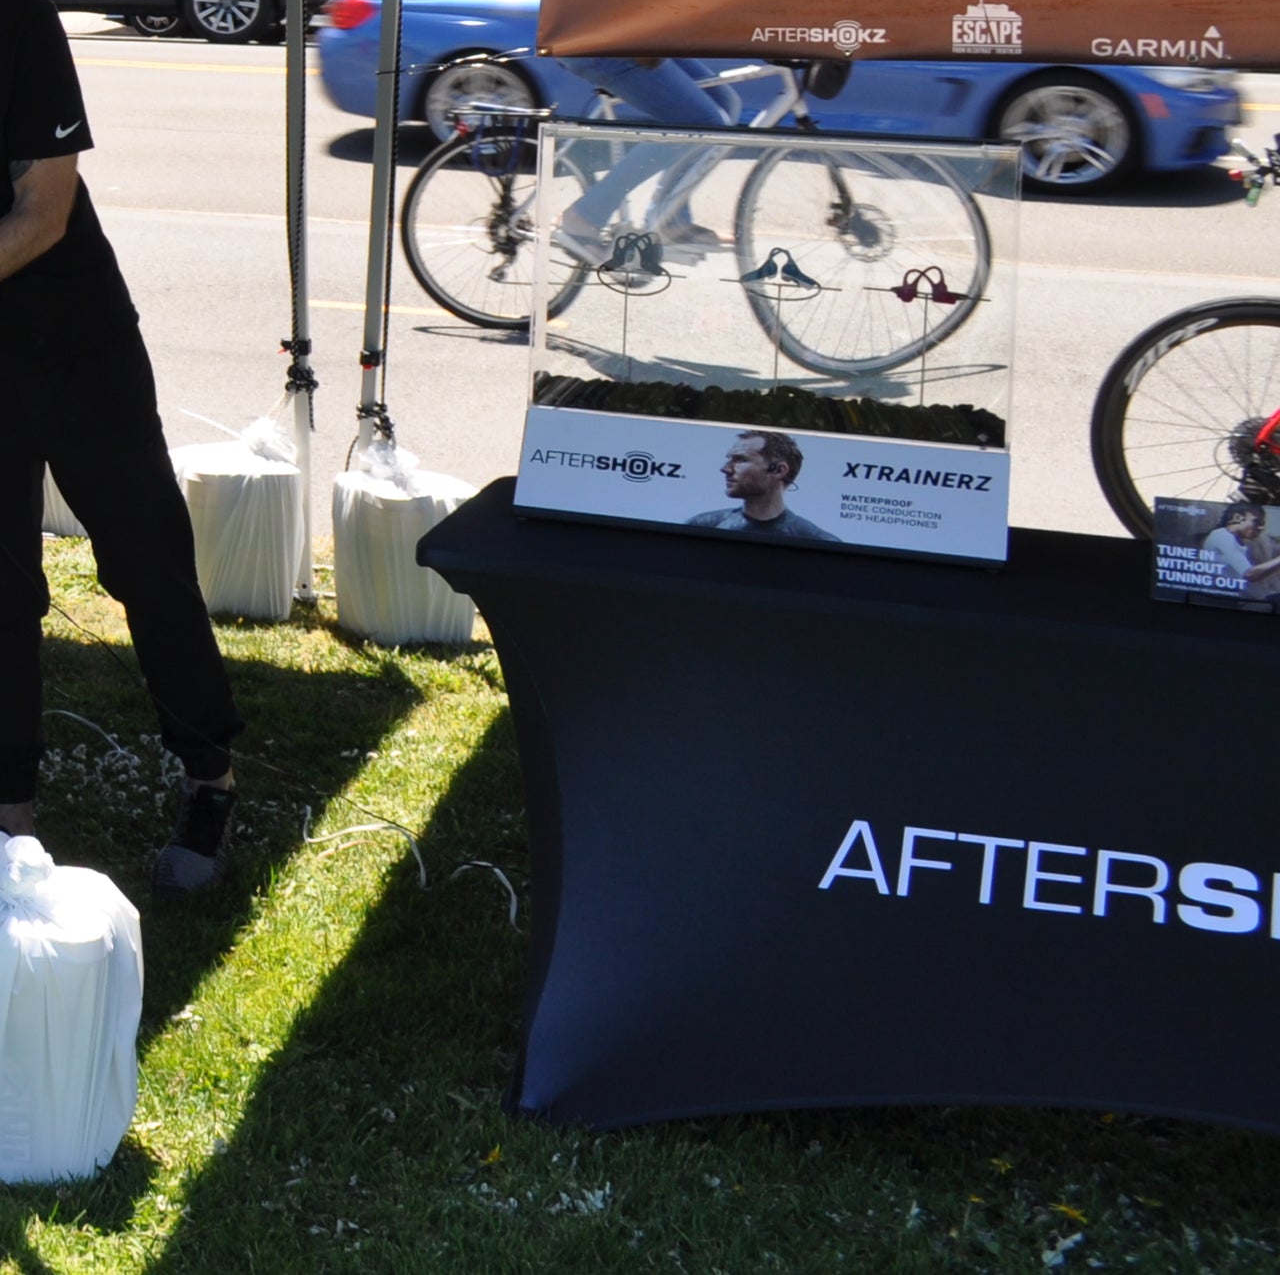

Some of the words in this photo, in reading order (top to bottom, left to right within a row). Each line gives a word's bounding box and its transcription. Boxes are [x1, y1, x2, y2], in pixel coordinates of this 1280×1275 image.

[751, 24, 886, 47] AFTERSHOKZ
[952, 20, 1022, 44] ESCAPE
[1091, 37, 1225, 59] GARMIN
[529, 449, 683, 481] AFTERSHOKZ
[843, 462, 993, 492] XTRAINERZ
[840, 503, 869, 513] BONE
[871, 505, 942, 520] CONDUCTION
[841, 494, 914, 508] WATERPROOF
[840, 512, 863, 521] MP3
[865, 515, 938, 529] HEADPHONES
[1157, 544, 1197, 559] TUNE
[1199, 549, 1216, 561] IN
[1156, 556, 1225, 575] WITHOUT
[1156, 569, 1213, 586] TUNING
[1215, 577, 1248, 590] OUT
[818, 819, 1280, 940] AFTERS
